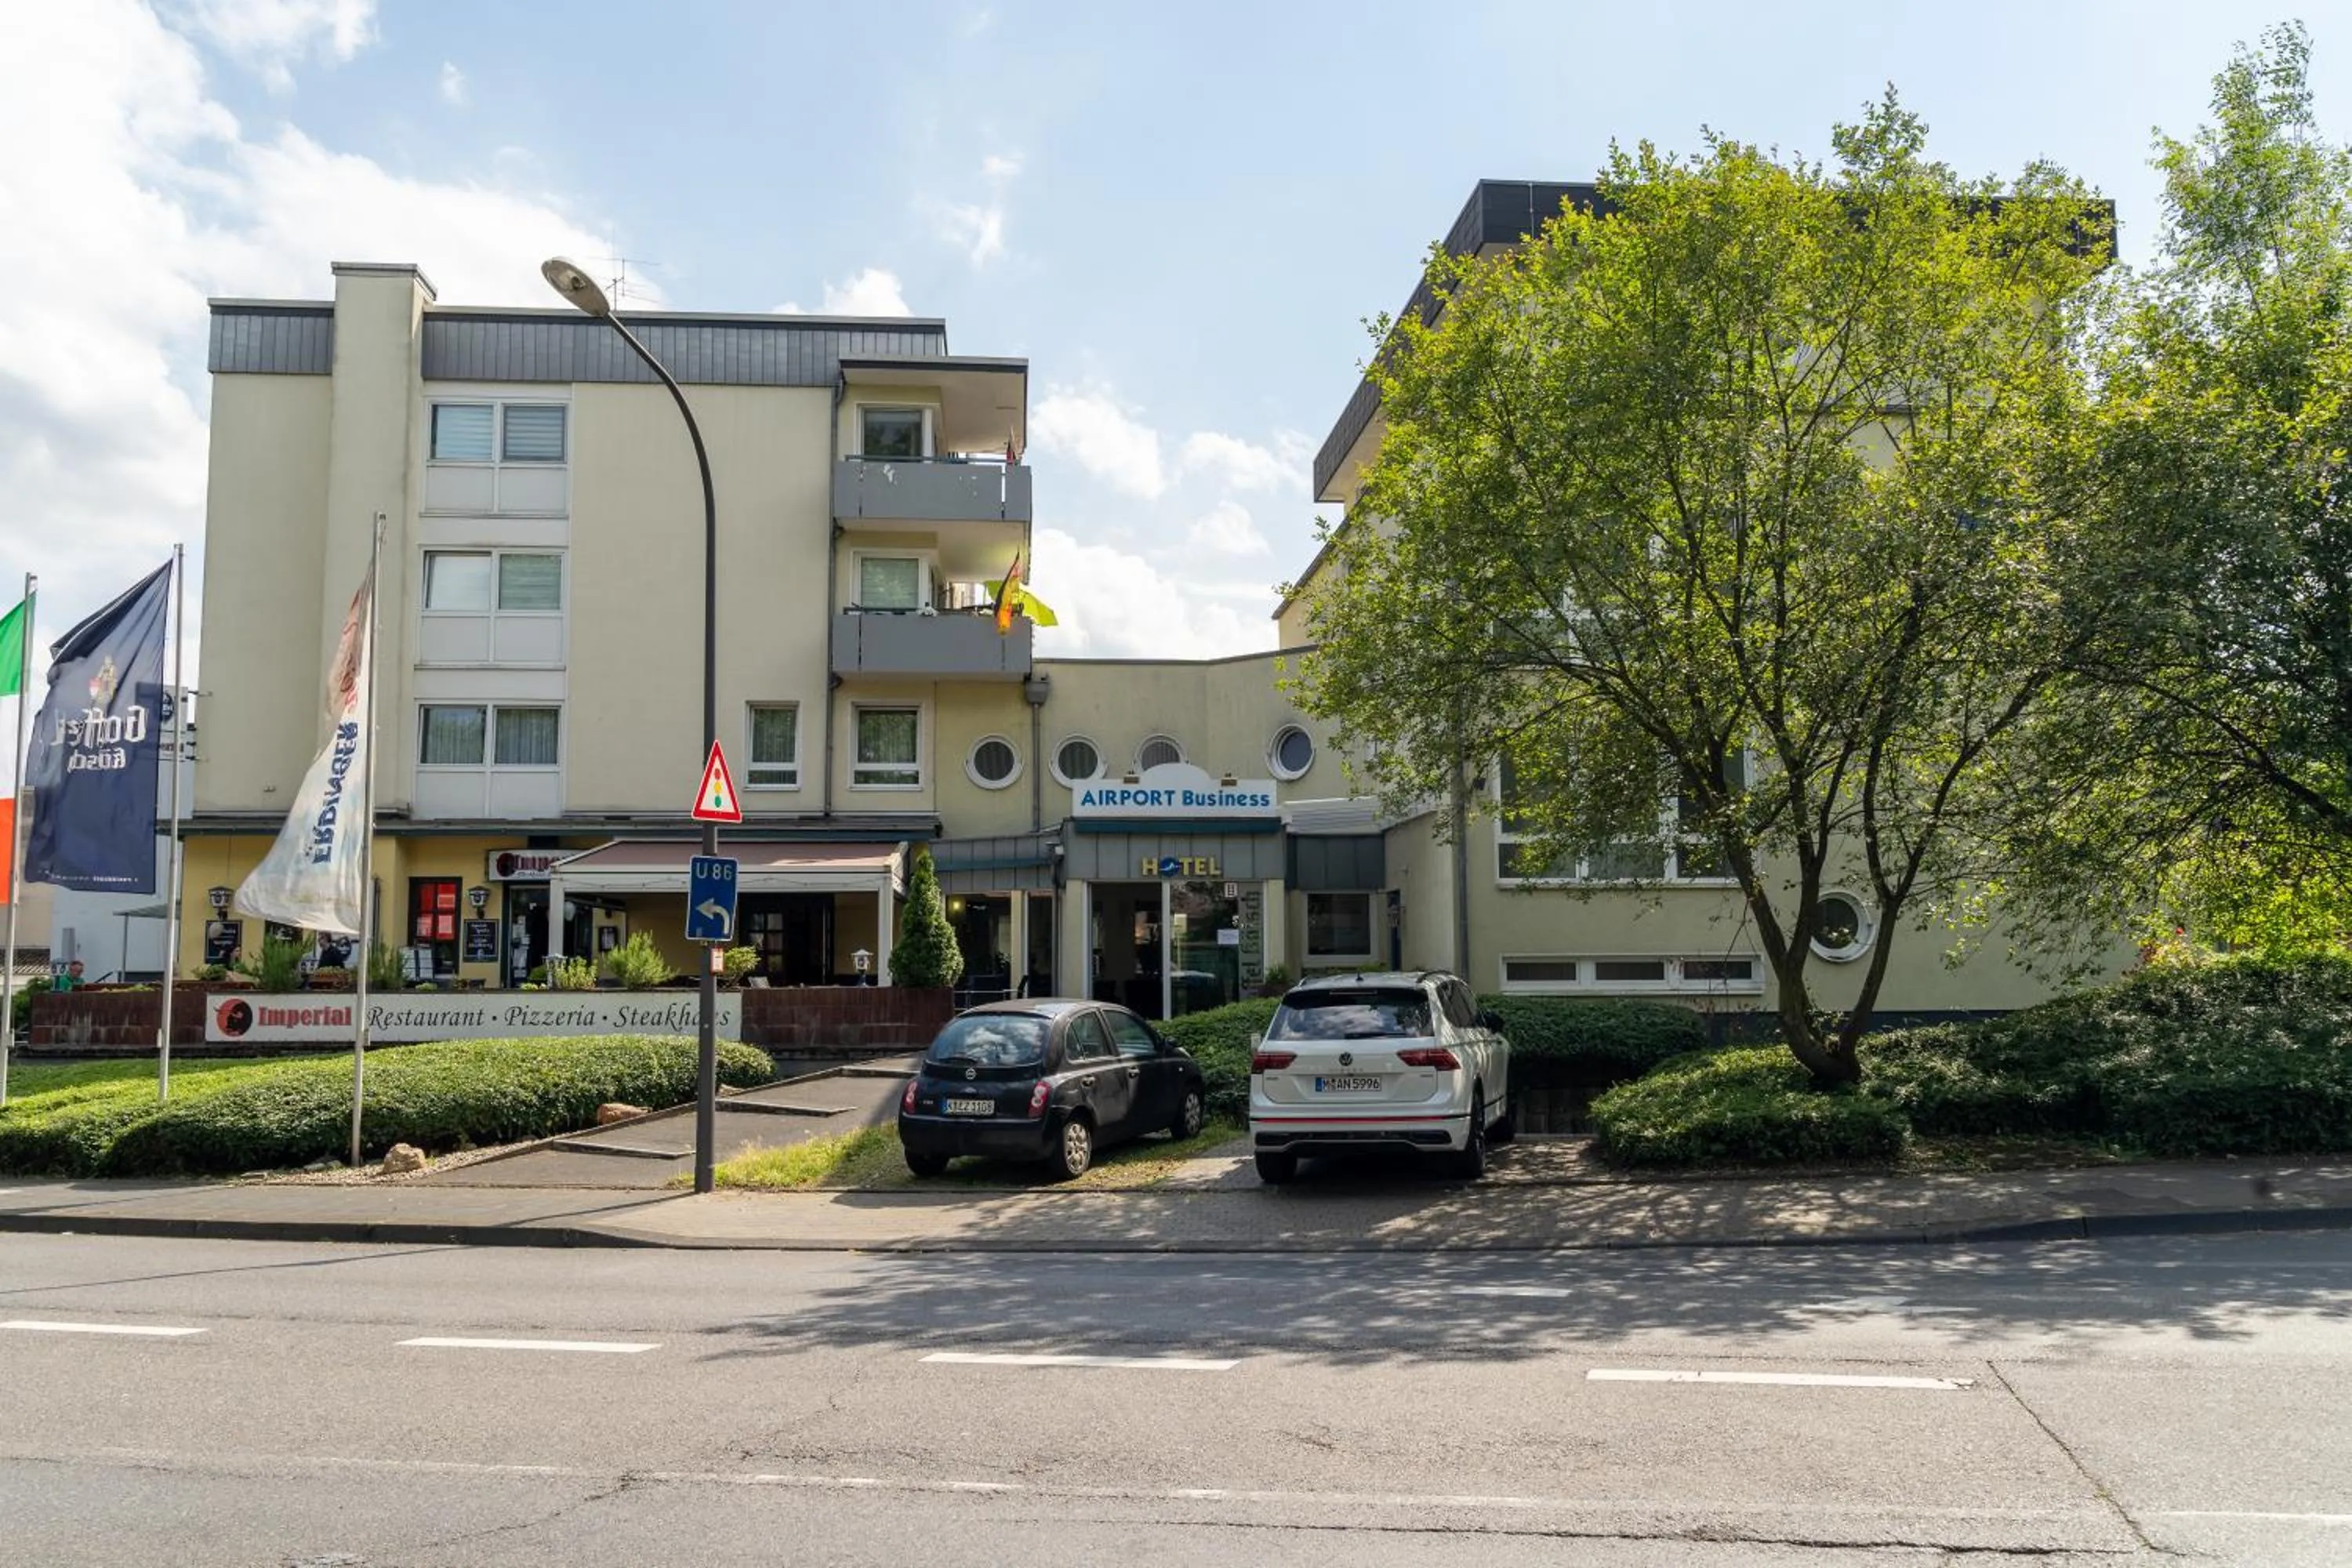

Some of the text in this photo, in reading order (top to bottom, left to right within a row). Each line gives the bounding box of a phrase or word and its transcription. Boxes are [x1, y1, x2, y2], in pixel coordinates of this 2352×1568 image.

[1080, 789, 1270, 807] AIRPORT Business
[696, 862, 732, 880] U 86
[1142, 857, 1221, 877] HOTEL
[258, 1002, 731, 1032] Imperial Restaurant Pizzeria Steakhas
